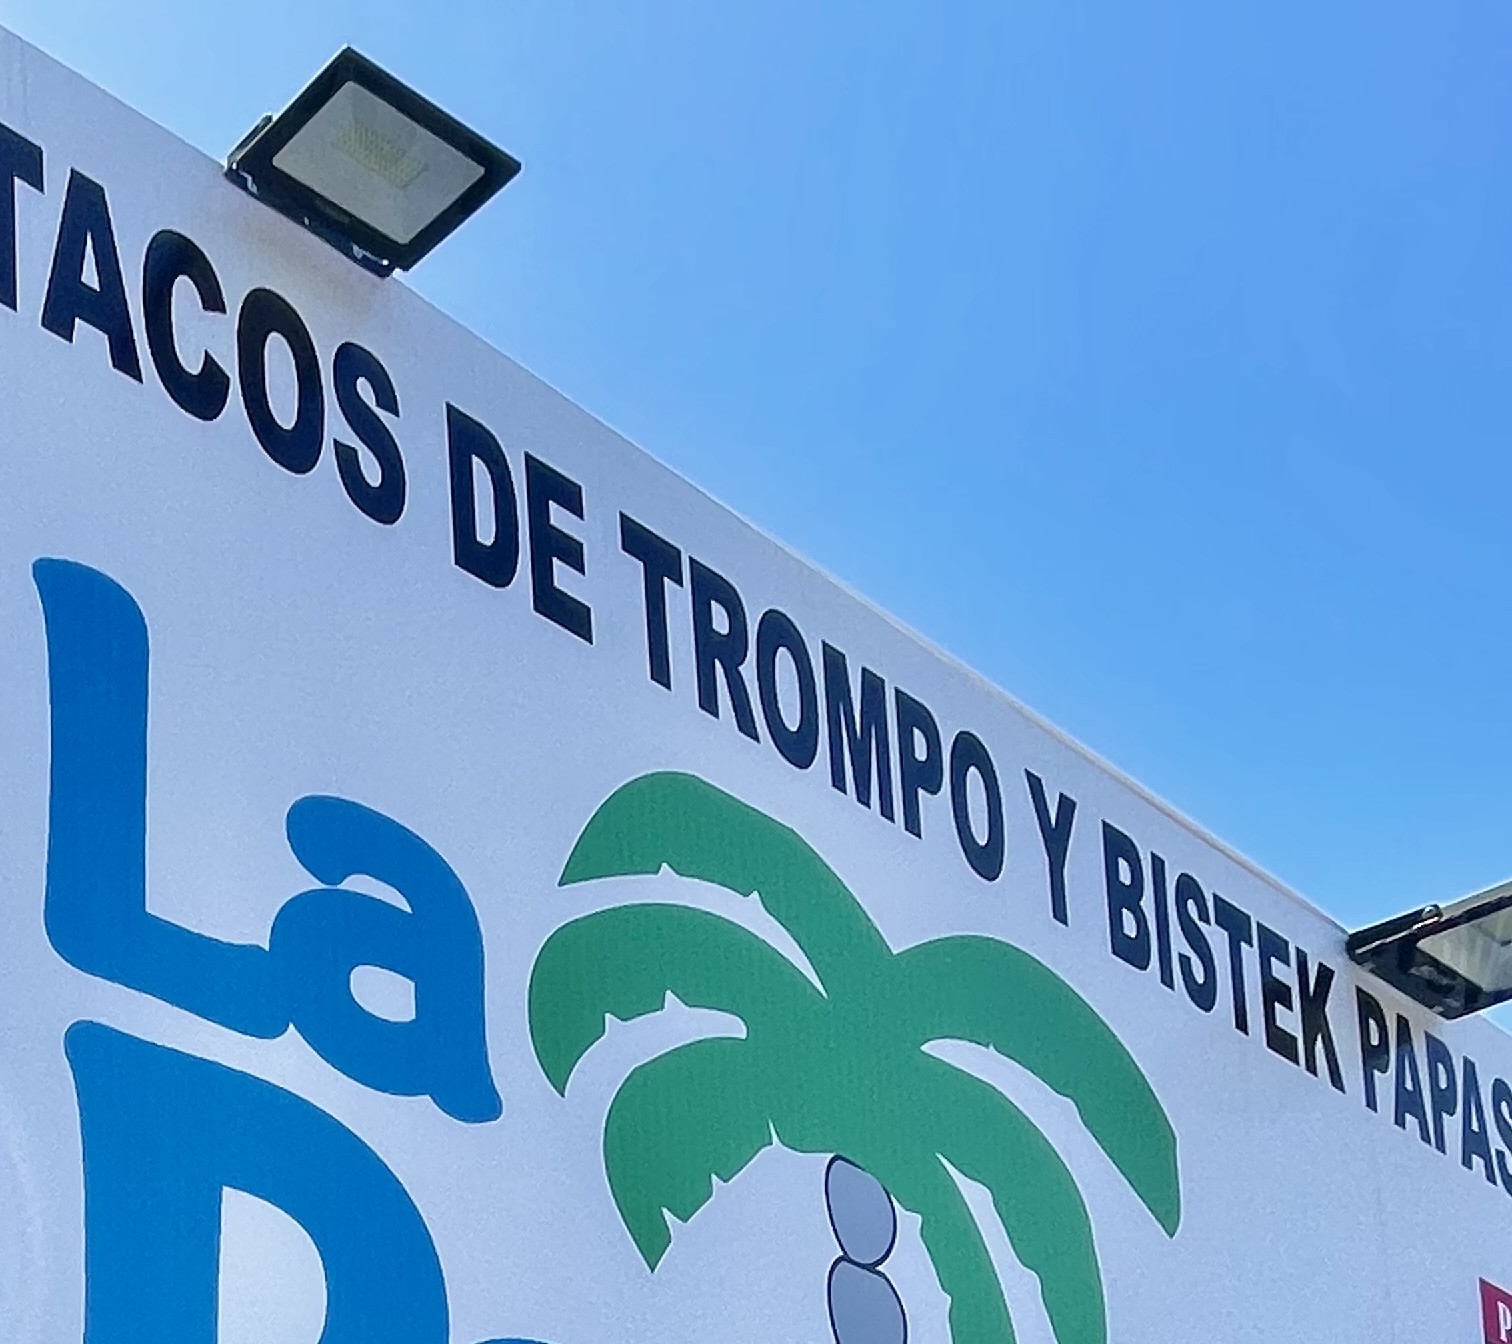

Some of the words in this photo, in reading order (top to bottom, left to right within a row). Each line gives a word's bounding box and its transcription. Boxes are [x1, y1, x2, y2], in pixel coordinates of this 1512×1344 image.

[31, 557, 503, 1124] La
[445, 402, 594, 646] DE
[619, 512, 1005, 884] TROMPO
[1024, 771, 1078, 930] Y
[1101, 818, 1347, 1095] BISTEK
[1354, 984, 1512, 1199] PAPAS
